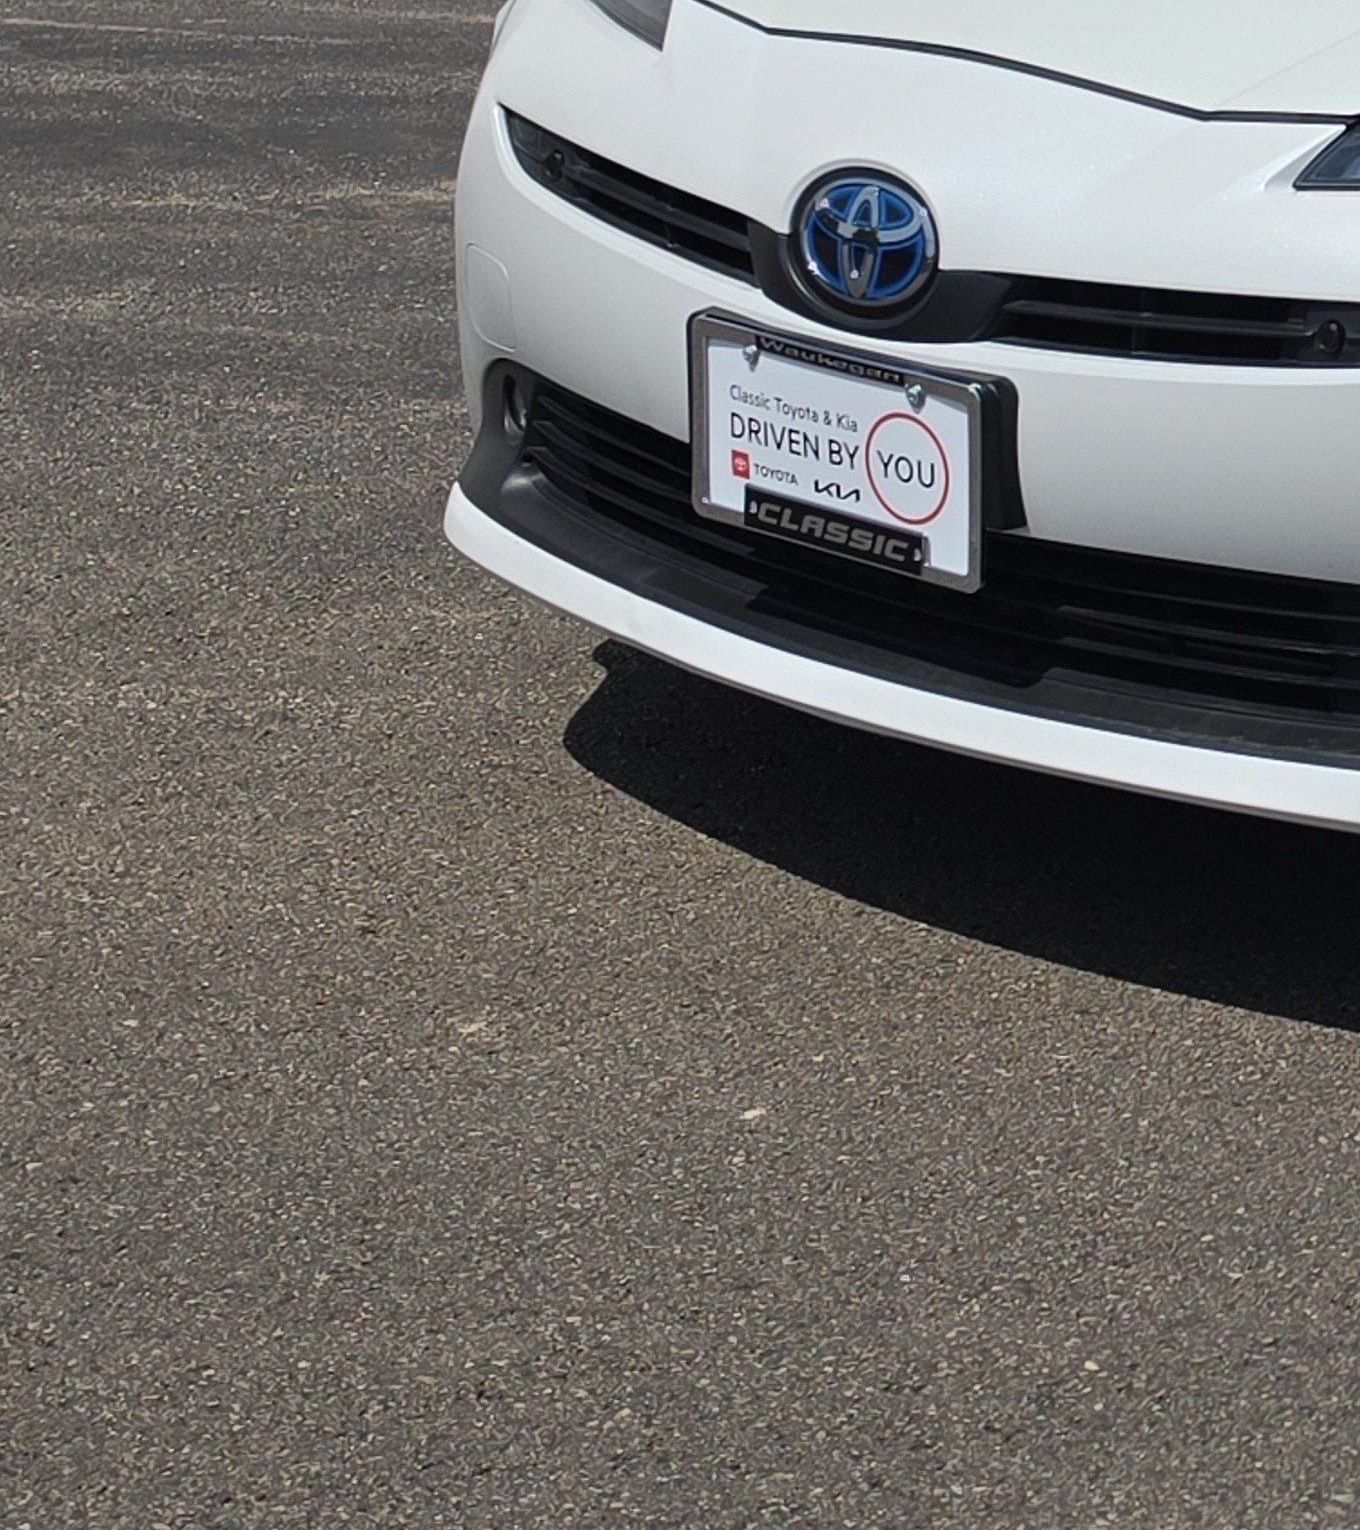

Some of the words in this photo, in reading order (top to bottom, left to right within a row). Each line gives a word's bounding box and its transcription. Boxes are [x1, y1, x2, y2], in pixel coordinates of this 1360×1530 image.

[759, 336, 901, 383] Waukegan
[729, 384, 771, 411] Classic
[773, 396, 819, 424] Toyota
[823, 410, 832, 426] &
[836, 413, 858, 433] Kia
[731, 411, 820, 462] DRIVEN
[828, 437, 860, 470] BY
[876, 449, 936, 489] YOU
[753, 463, 799, 486] TOYOTA
[757, 501, 909, 562] CLASSIC
